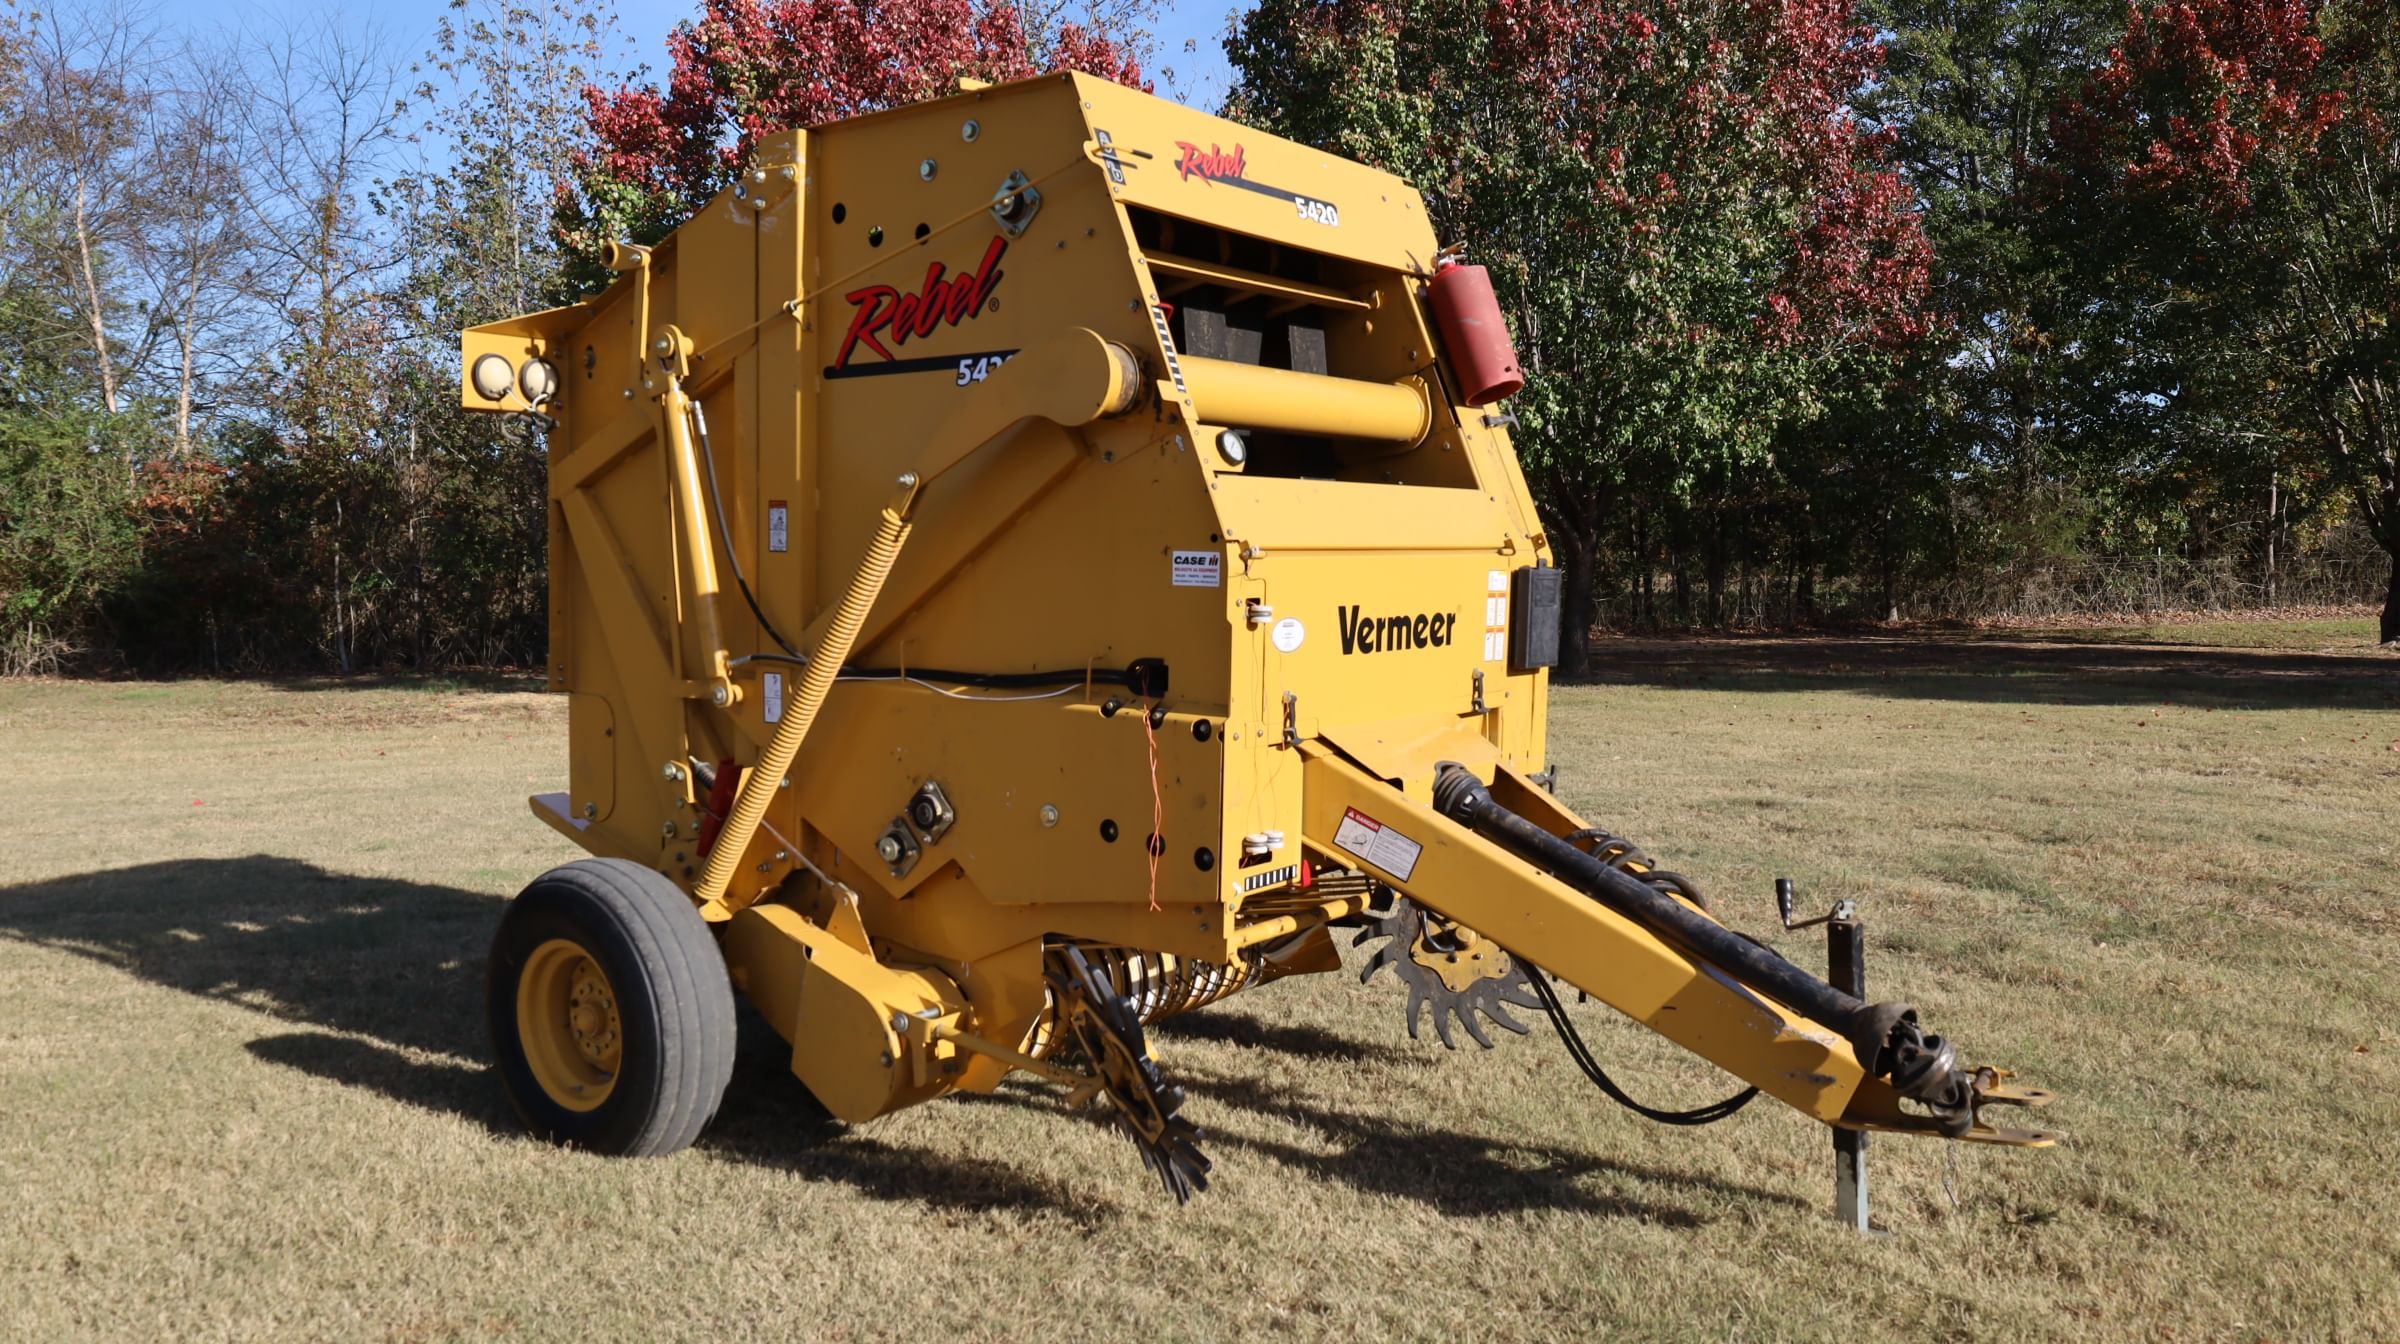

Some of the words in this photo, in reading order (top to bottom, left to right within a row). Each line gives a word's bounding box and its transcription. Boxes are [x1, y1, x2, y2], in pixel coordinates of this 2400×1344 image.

[1175, 141, 1246, 188] Rebel
[1295, 197, 1339, 228] 5420
[833, 235, 1008, 370] Rebel
[1174, 555, 1206, 566] CASE
[1338, 605, 1456, 655] Vermeer
